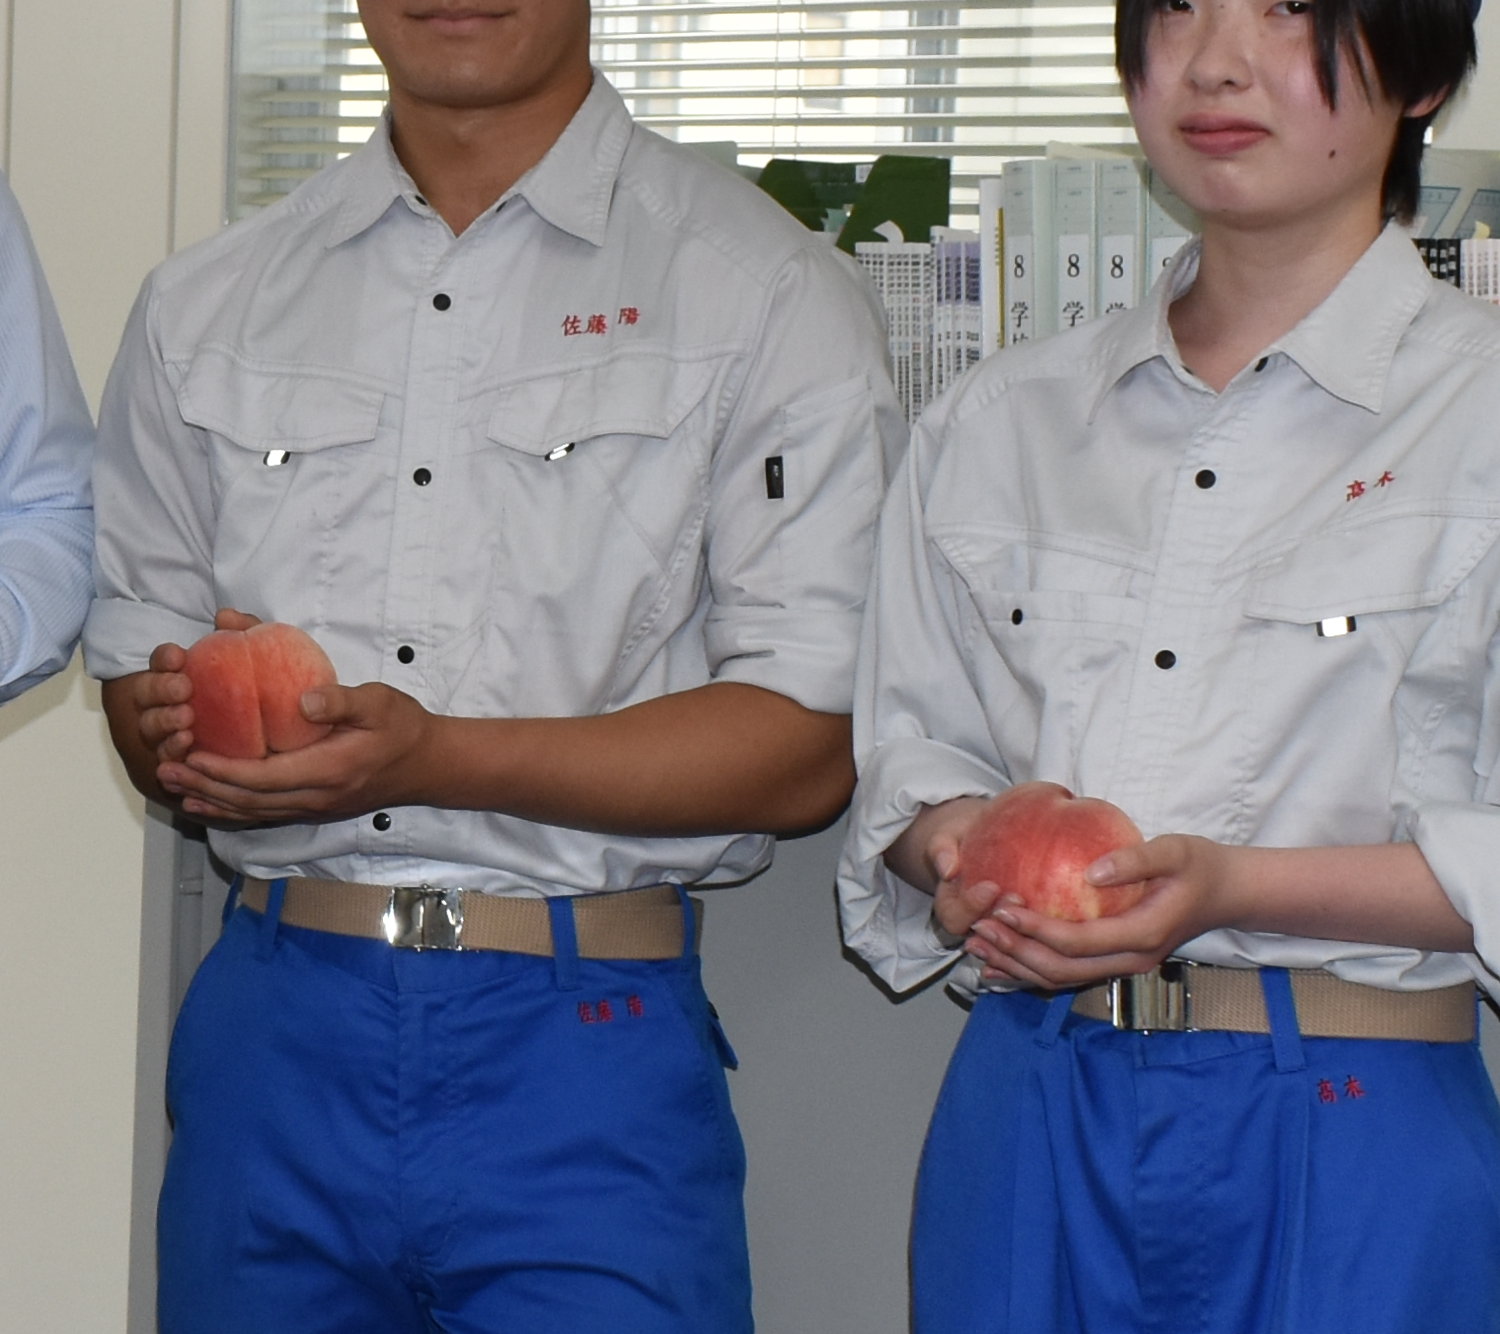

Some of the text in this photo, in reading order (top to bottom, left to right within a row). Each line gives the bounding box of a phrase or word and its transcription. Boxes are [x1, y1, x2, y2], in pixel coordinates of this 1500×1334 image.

[1014, 255, 1024, 278] 8
[1068, 254, 1080, 277] 8
[1111, 255, 1123, 278] 8
[561, 314, 608, 336] 佐藤
